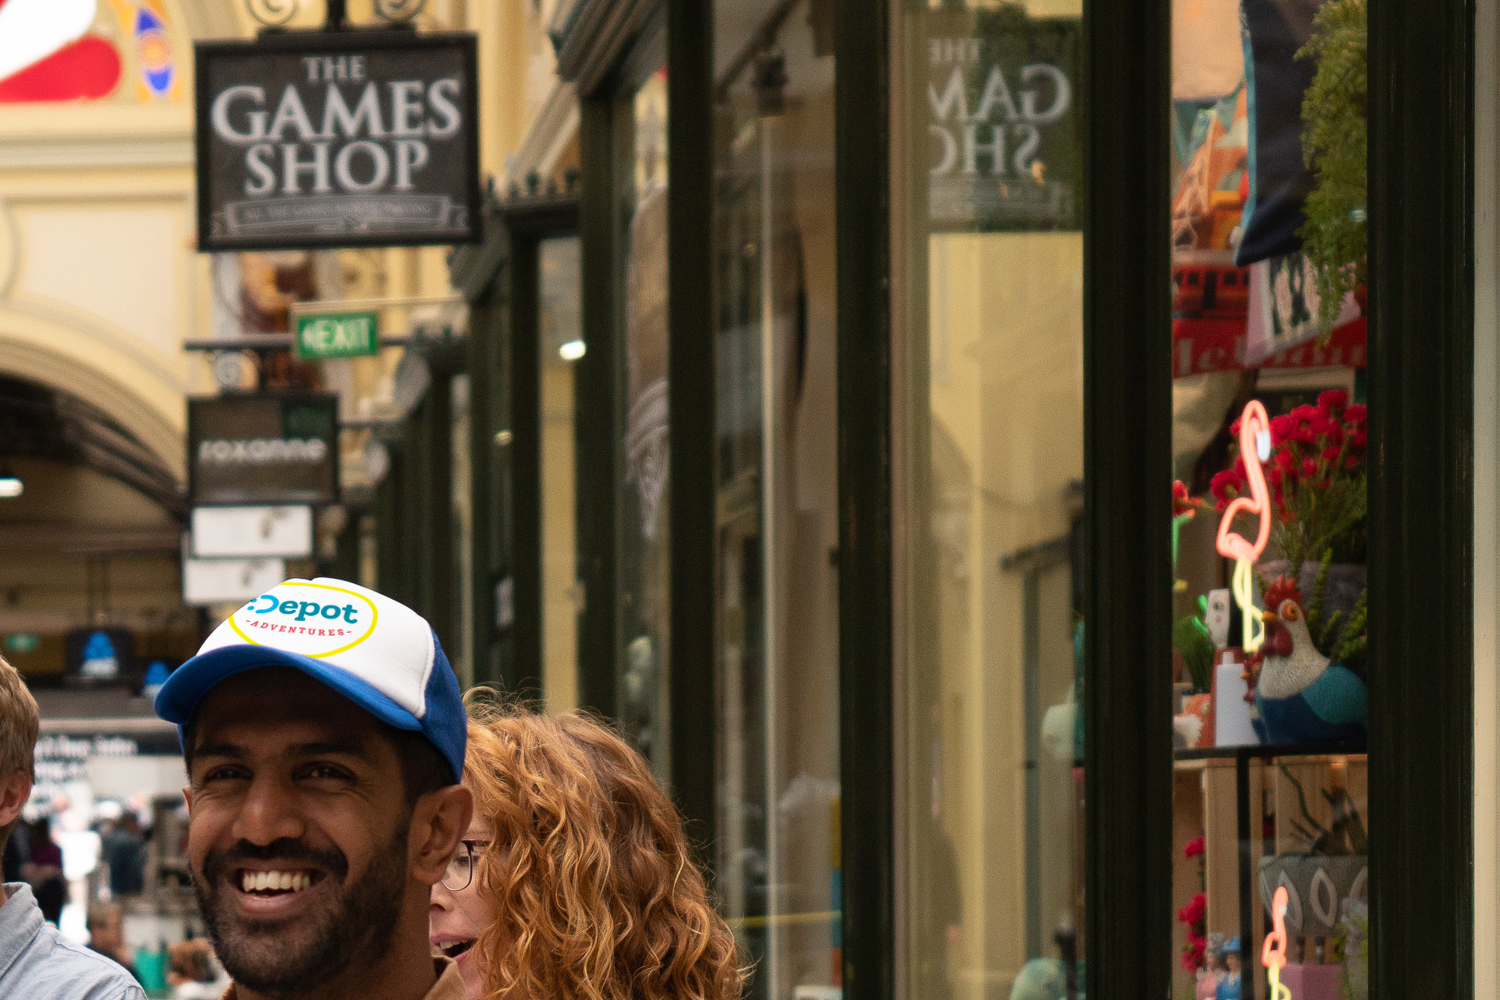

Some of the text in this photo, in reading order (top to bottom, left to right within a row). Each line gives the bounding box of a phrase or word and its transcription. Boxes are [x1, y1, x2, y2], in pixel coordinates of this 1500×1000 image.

[303, 55, 365, 81] THE
[211, 79, 461, 145] GAMES
[244, 139, 429, 196] SHOP
[314, 317, 370, 350] EXIT
[198, 437, 327, 463] roxanne
[247, 594, 358, 625] Depot
[249, 620, 346, 637] ADVENTURES
